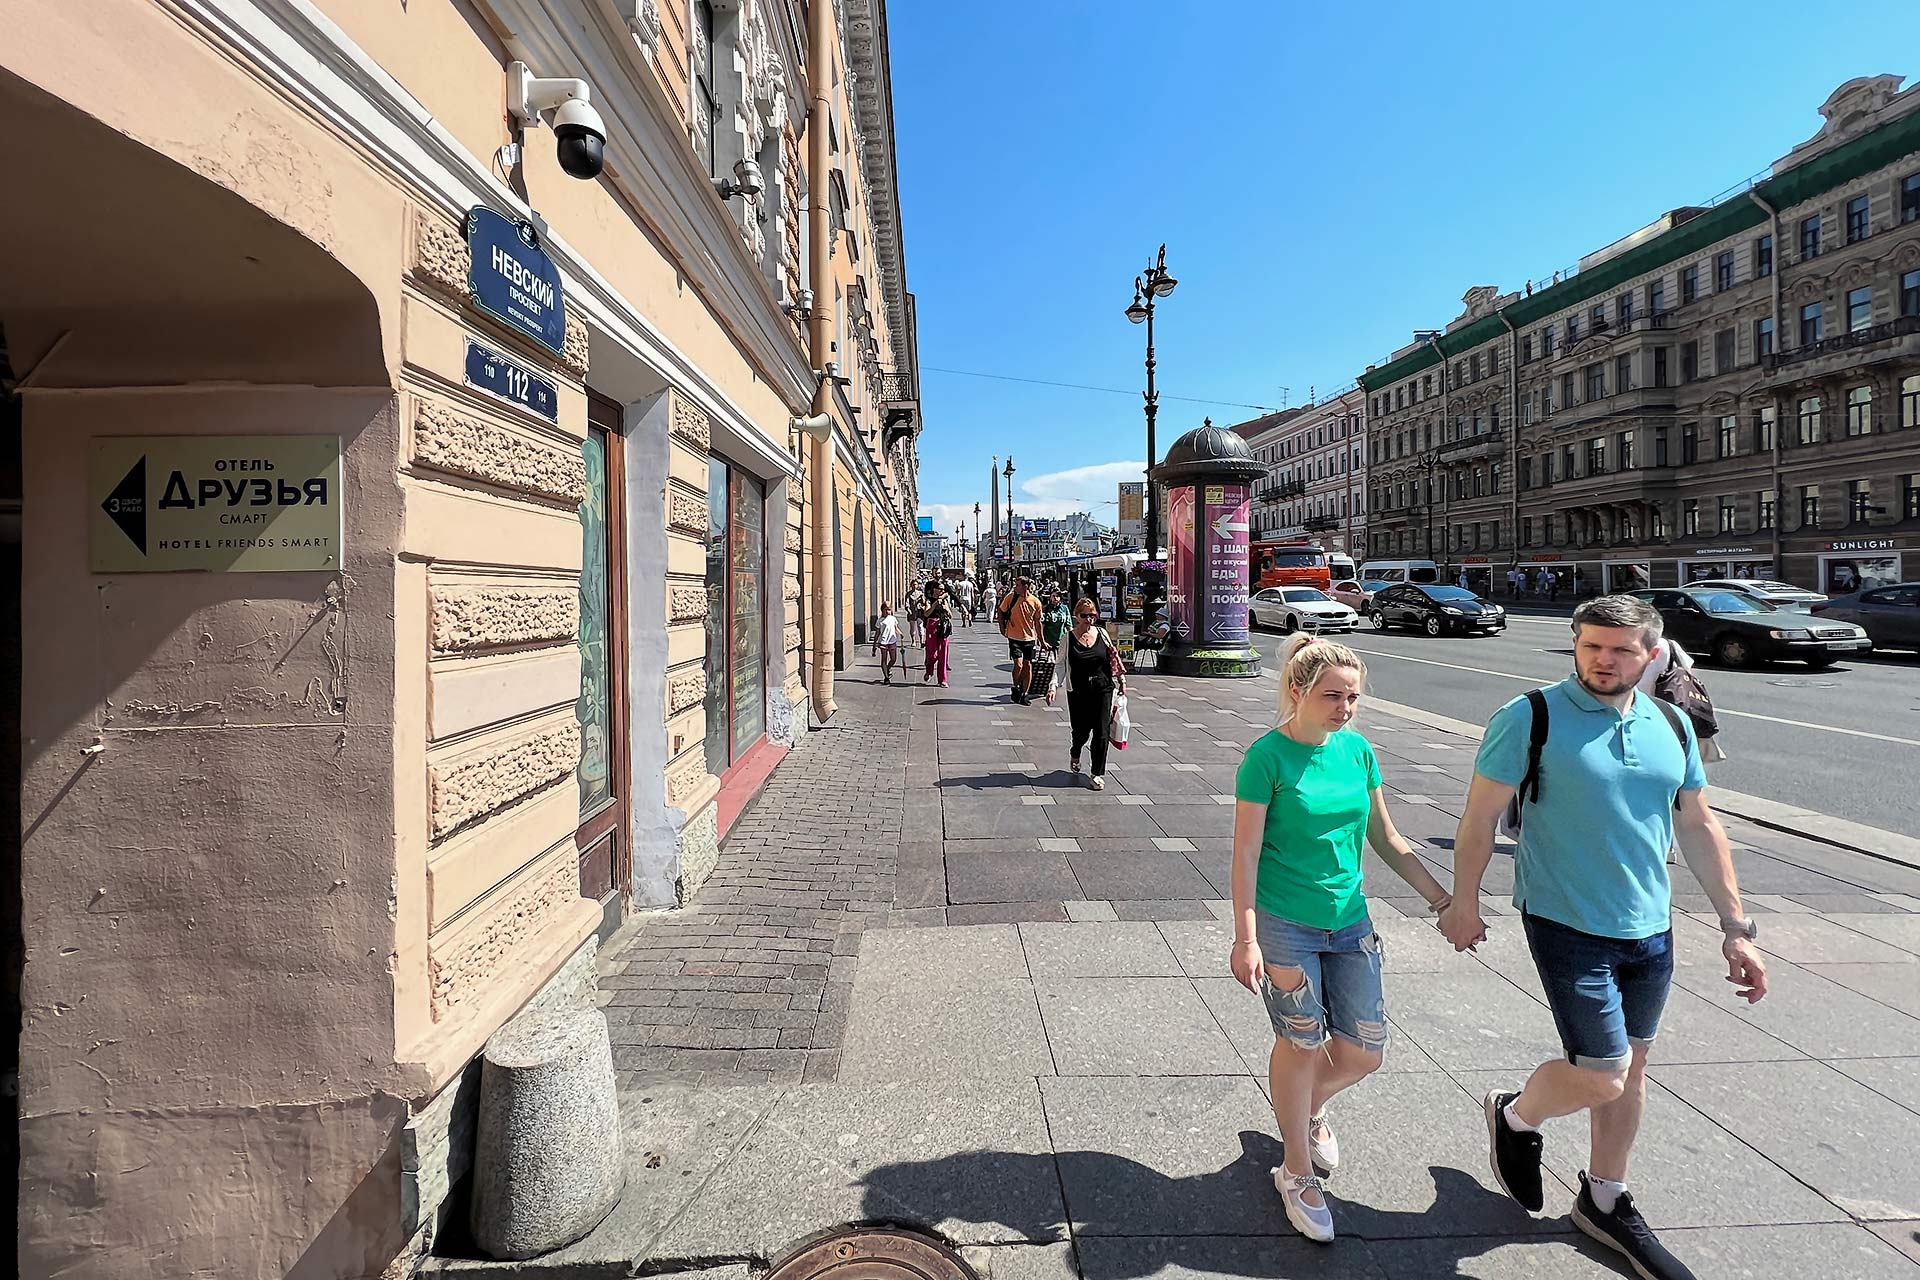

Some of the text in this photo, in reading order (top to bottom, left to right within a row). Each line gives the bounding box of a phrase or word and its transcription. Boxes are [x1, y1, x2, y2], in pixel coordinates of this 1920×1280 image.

[492, 244, 554, 311] НЕВСКИЙ
[509, 285, 542, 317] ПРОСПЕКТ
[484, 363, 495, 379] 110
[506, 366, 529, 402] 112
[214, 459, 275, 472] ОТЕЛЬ
[110, 498, 120, 513] 3
[121, 505, 142, 513] YARD
[219, 513, 268, 525] СМАРТ
[159, 537, 329, 549] HOTEL FRIENDS SMART
[1211, 544, 1221, 554] В
[1832, 539, 1895, 550] SUNLIGHT
[1211, 569, 1239, 580] ЕДЫ
